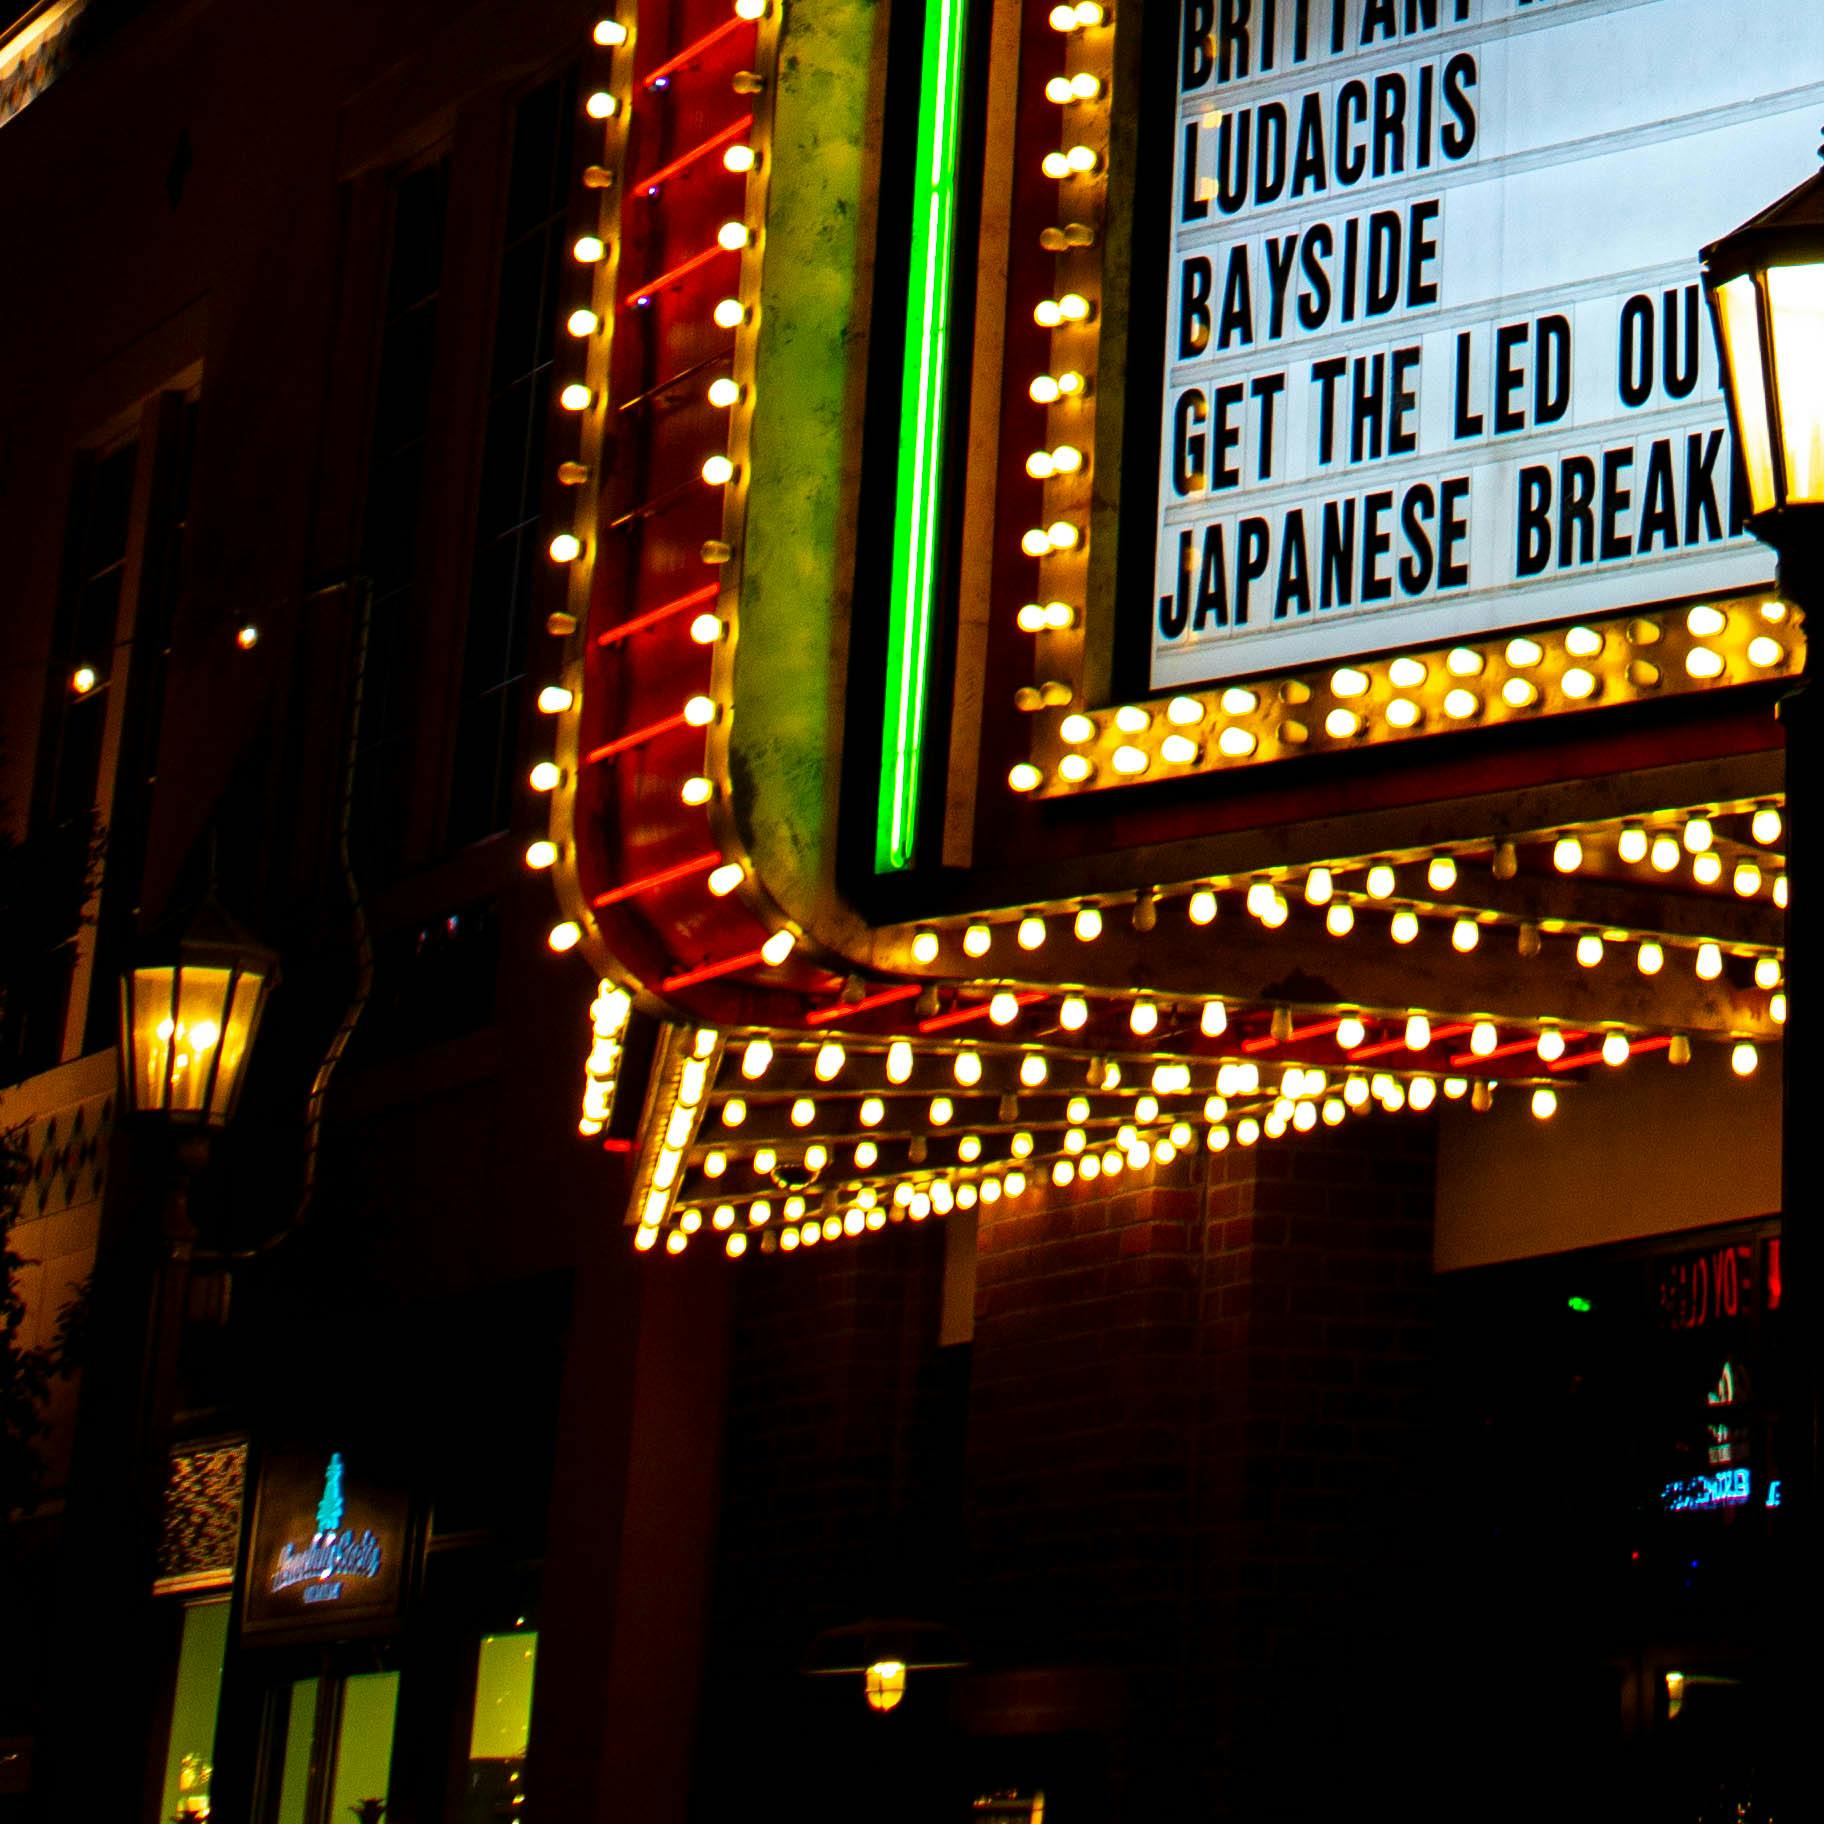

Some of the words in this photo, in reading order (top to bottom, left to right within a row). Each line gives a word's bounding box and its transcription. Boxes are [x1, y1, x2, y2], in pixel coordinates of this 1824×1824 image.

[1181, 52, 1477, 224] LUDACRIS
[1178, 199, 1440, 361] BAYSIDE
[1173, 372, 1286, 497] GET
[1310, 345, 1422, 466] THE
[1452, 313, 1572, 441] LED
[1618, 283, 1729, 408] OU
[1158, 475, 1470, 641] JAPANESE
[1515, 427, 1745, 578] BREAK
